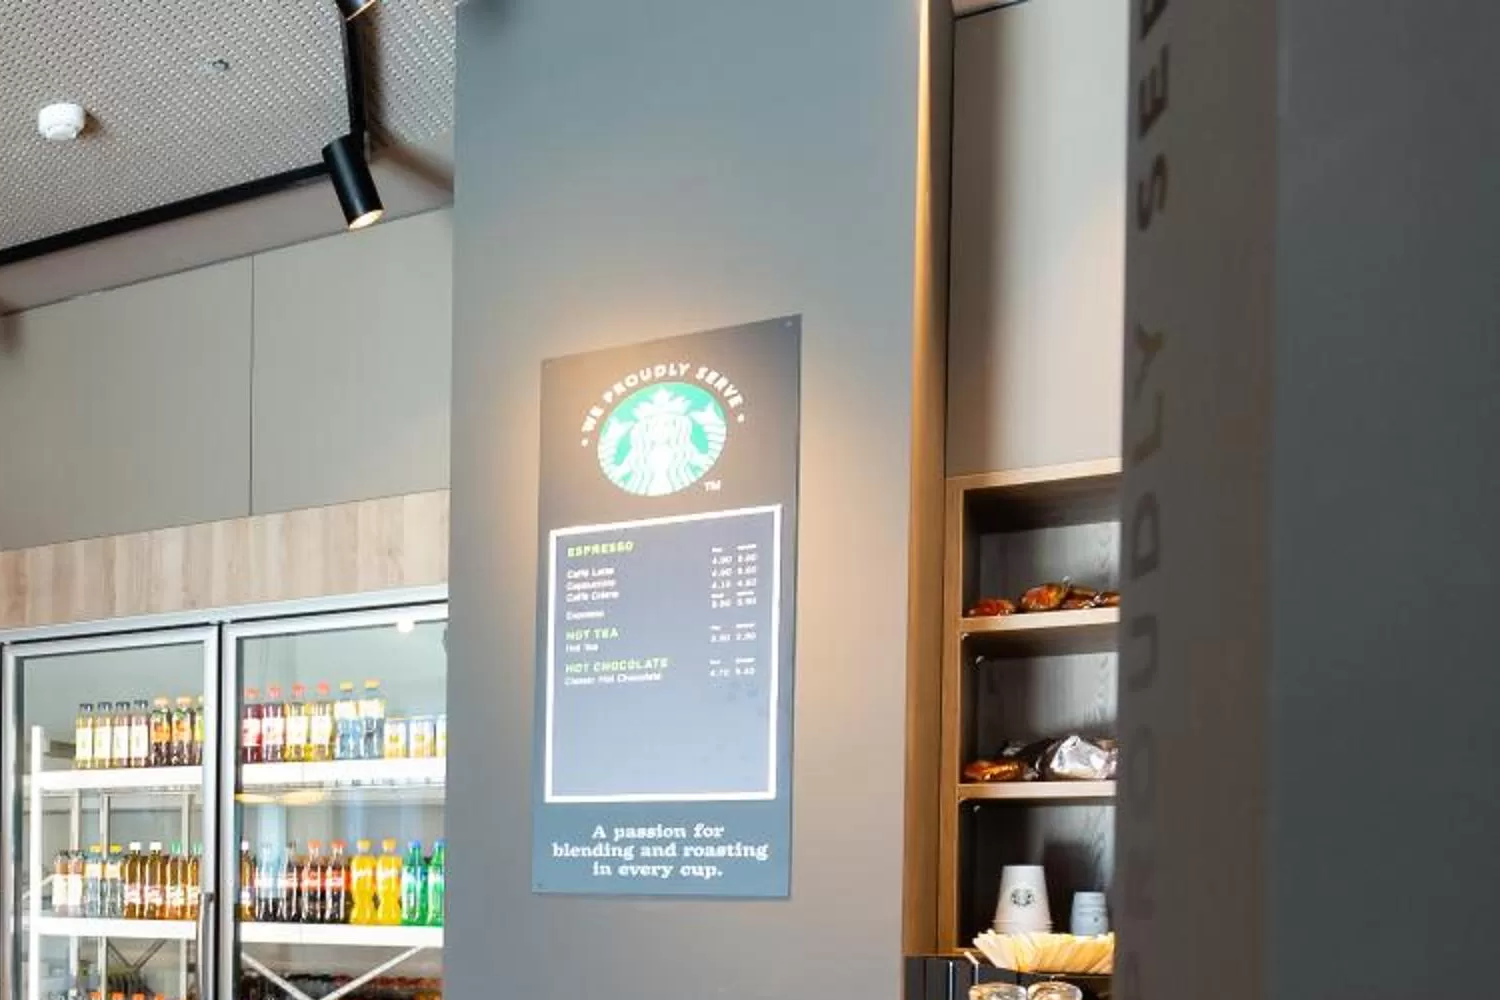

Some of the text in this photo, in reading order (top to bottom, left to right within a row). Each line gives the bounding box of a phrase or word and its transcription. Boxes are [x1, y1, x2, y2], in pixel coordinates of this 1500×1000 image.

[581, 361, 745, 434] WE PROUDLY SERVE
[704, 480, 721, 491] TM
[567, 540, 635, 557] ESPRESSO
[565, 627, 620, 641] HOT TEA
[565, 657, 669, 673] HOT CHOCOLATE
[592, 823, 725, 842] A passion for
[552, 842, 770, 861] blending and roasting
[592, 861, 723, 880] in every cup.
